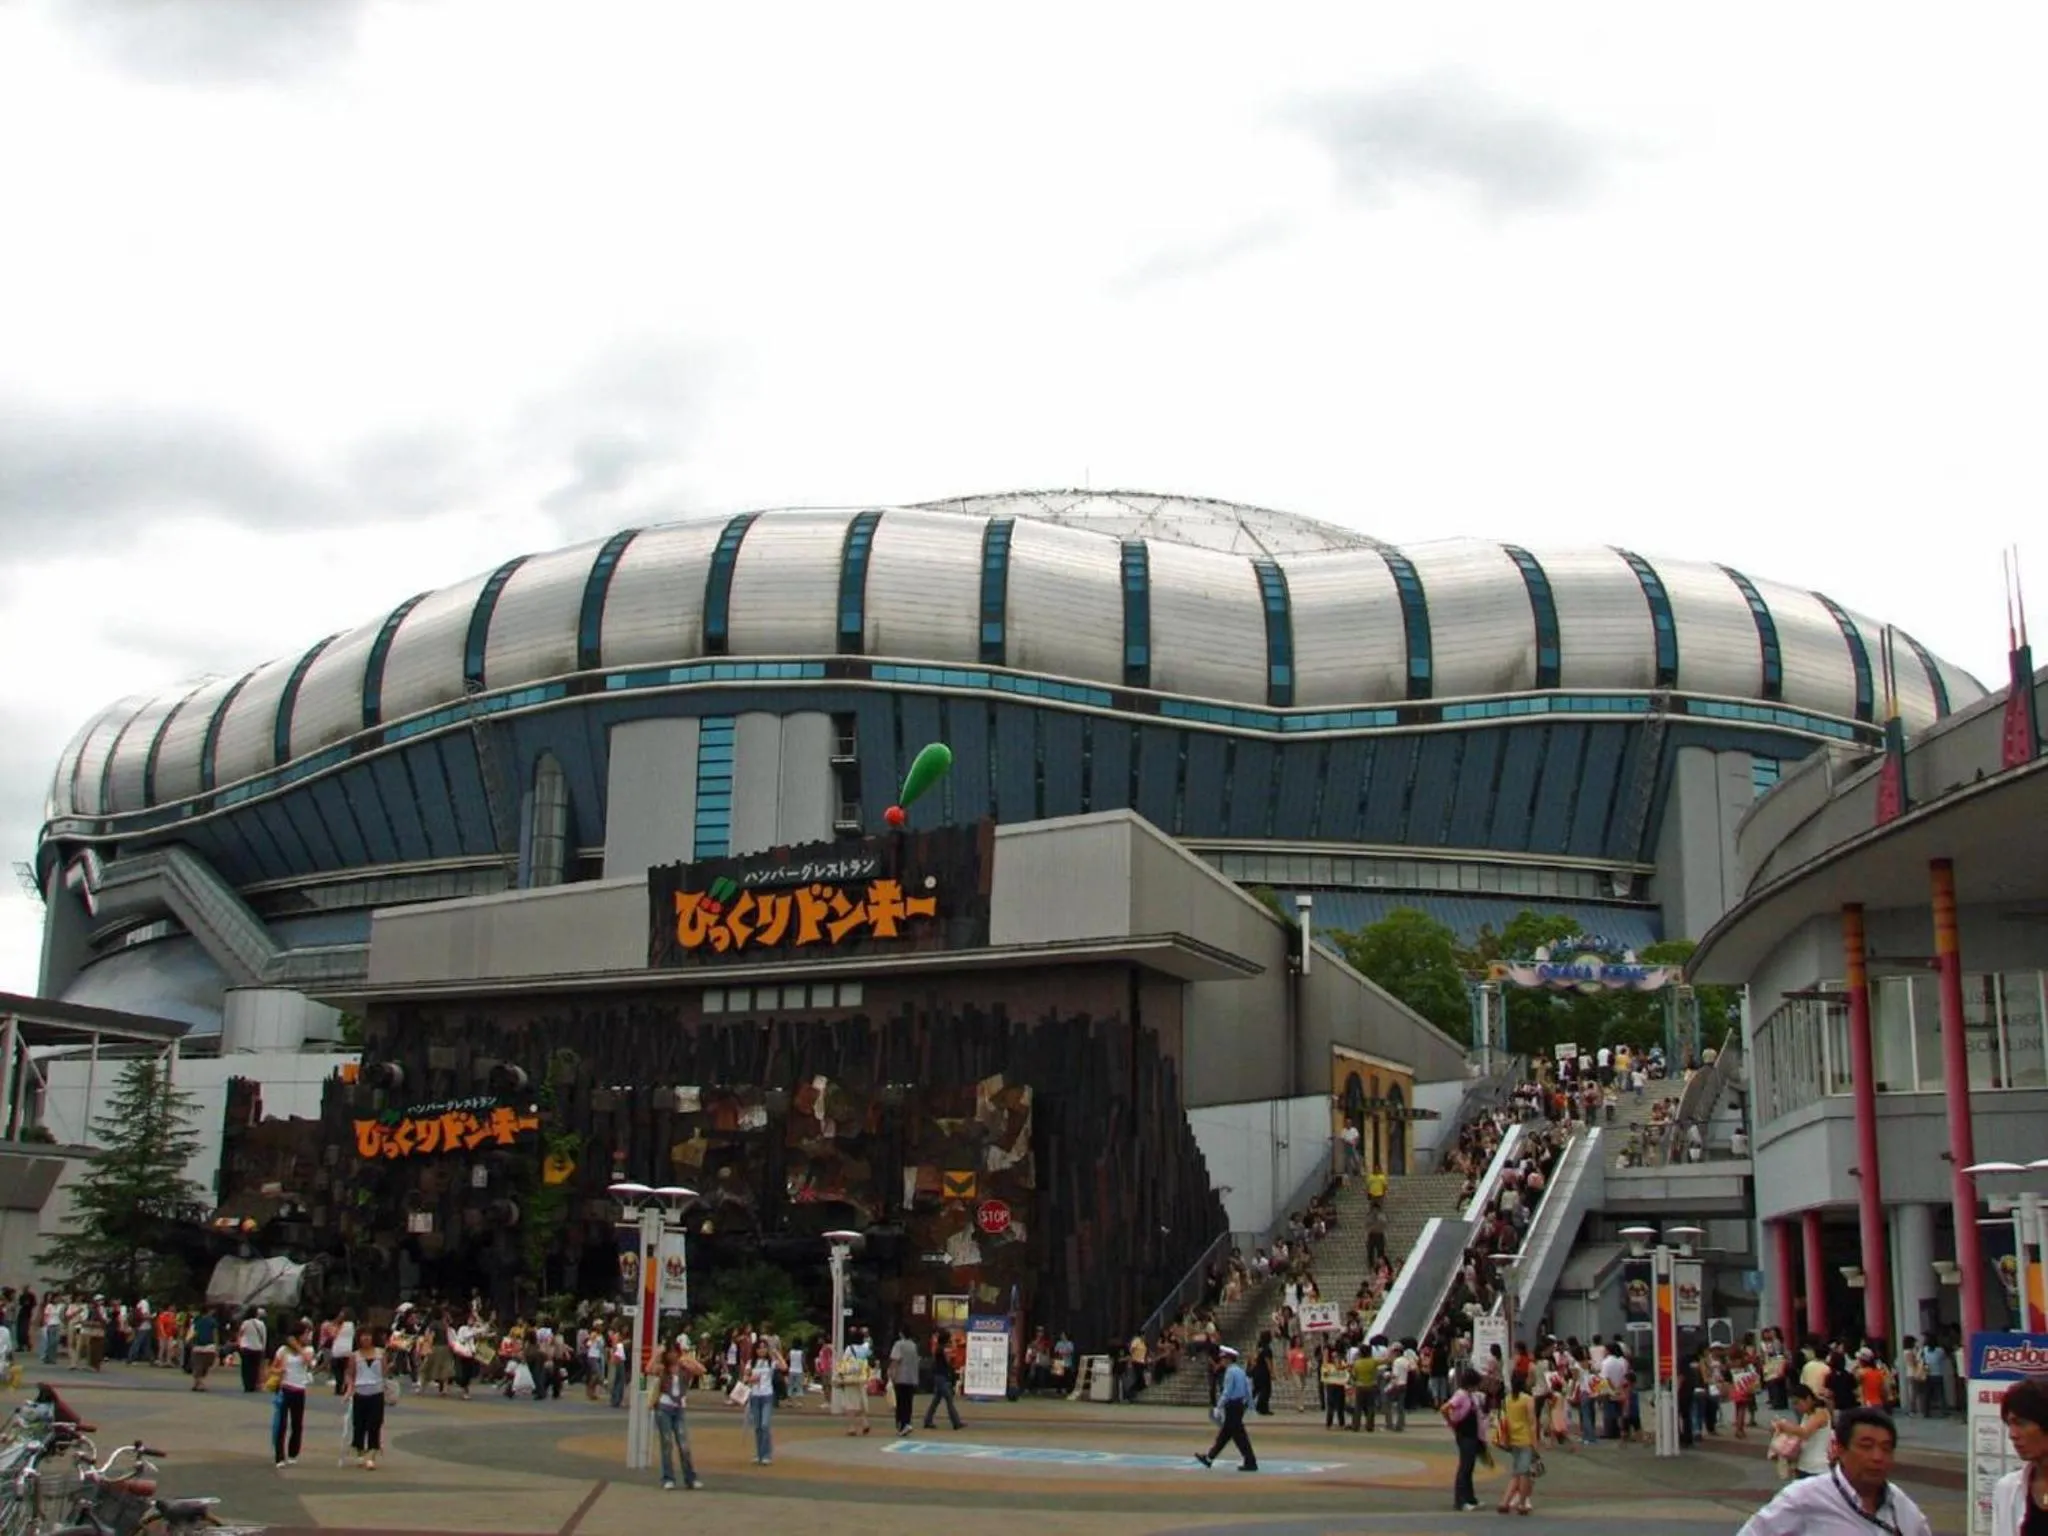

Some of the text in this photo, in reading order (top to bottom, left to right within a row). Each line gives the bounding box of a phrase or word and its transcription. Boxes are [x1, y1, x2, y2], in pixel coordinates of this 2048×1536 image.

[743, 858, 876, 883] ハンバーグレストラン
[673, 878, 938, 954] びっくりドンキー
[353, 1106, 540, 1160] びっくりドンキー
[981, 1210, 1009, 1224] STOP
